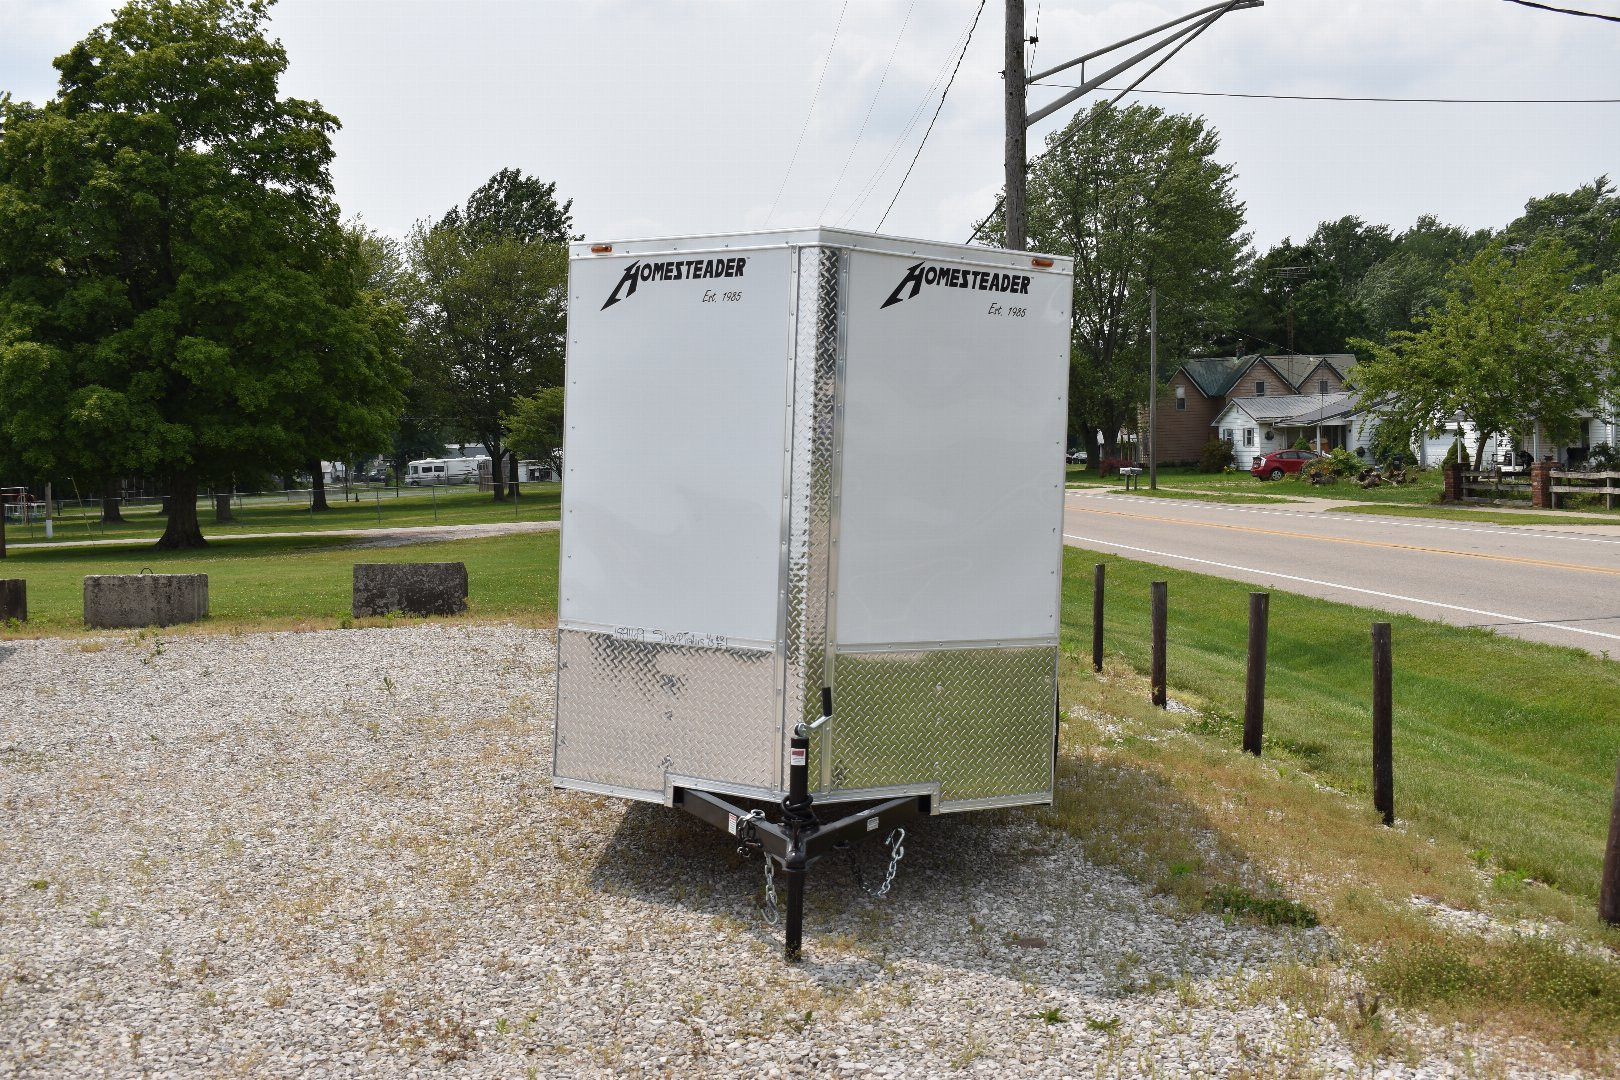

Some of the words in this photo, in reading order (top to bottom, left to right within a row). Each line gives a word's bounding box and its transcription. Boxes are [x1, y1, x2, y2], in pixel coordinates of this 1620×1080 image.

[600, 257, 747, 311] HOMESTEADER
[721, 291, 743, 302] 1985
[879, 260, 1032, 310] HOMESTEADER
[1007, 306, 1027, 318] 1985
